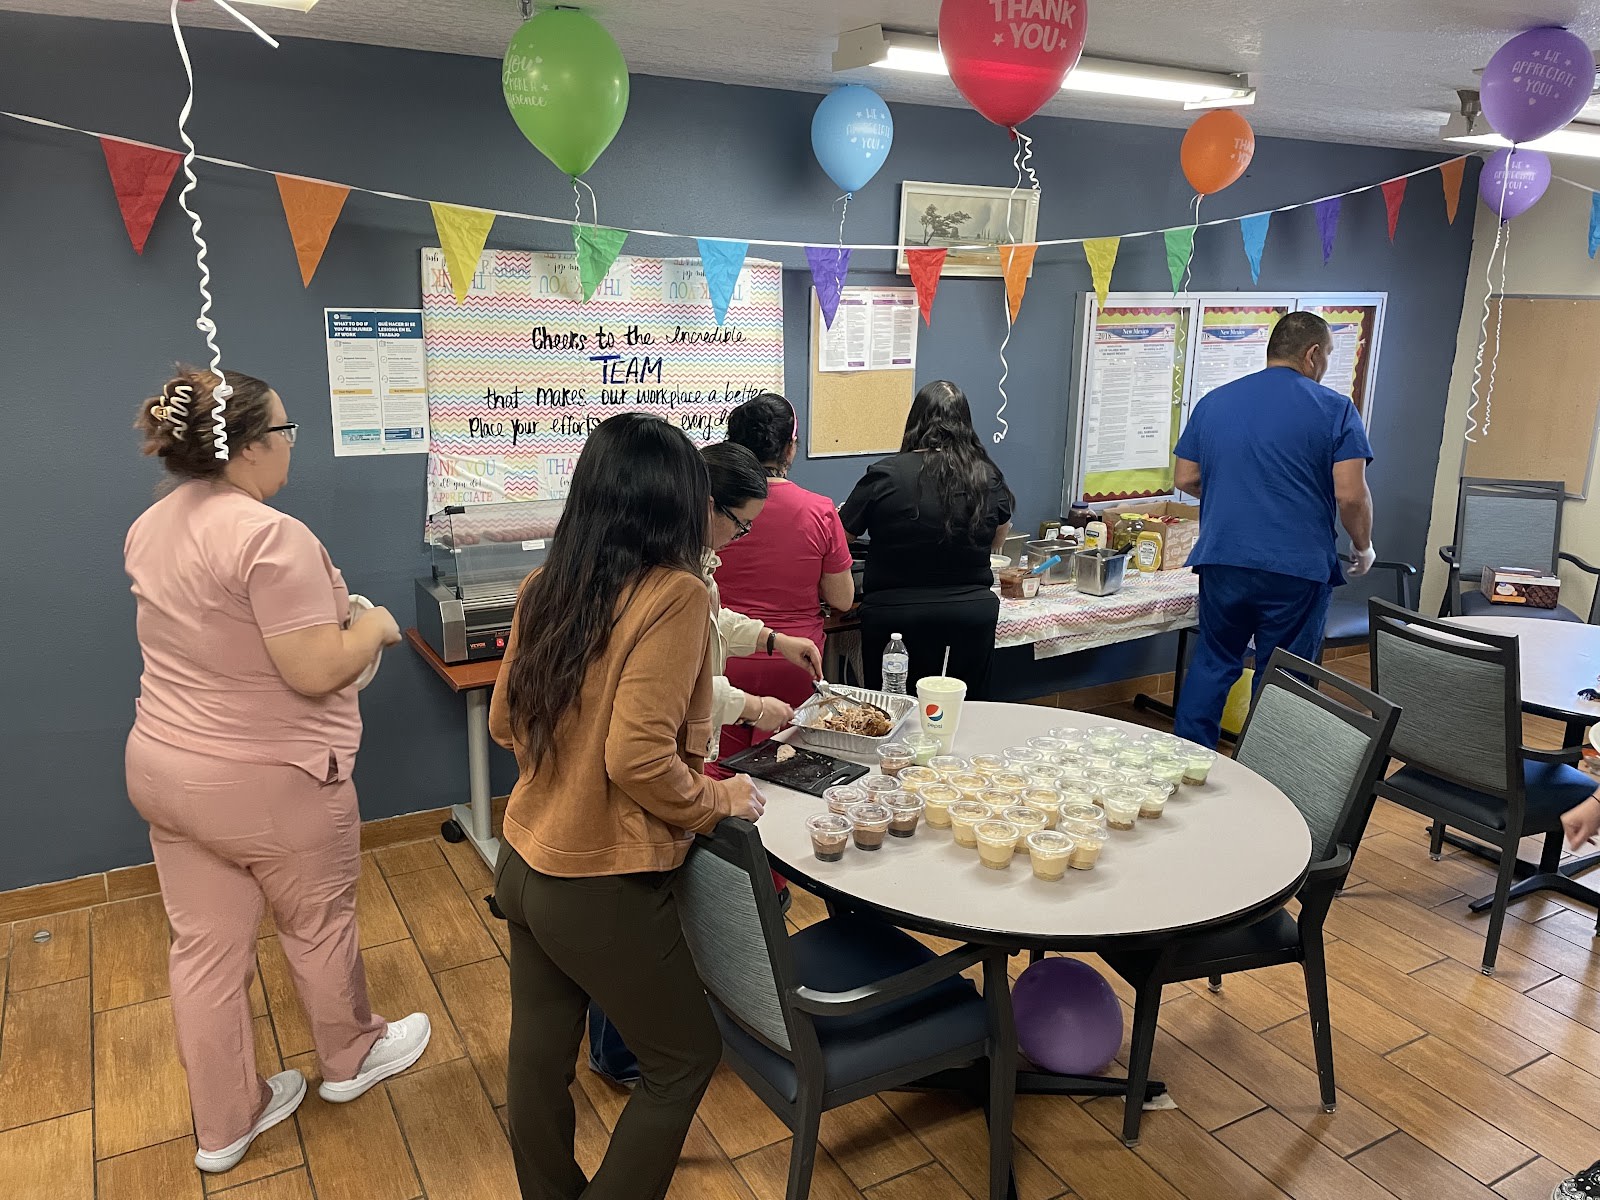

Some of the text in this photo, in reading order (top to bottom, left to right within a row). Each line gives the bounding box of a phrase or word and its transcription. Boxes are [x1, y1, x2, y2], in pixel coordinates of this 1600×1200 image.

[989, 0, 1076, 29] THANK
[1009, 21, 1059, 52] YOU
[1544, 50, 1562, 64] WE
[1511, 61, 1577, 88] APPRECIATE
[1525, 78, 1553, 97] YOU!
[596, 325, 615, 349] to
[624, 325, 655, 346] the
[590, 354, 663, 384] TEAM
[483, 386, 523, 409] that
[601, 388, 627, 405] our
[637, 383, 705, 409] workplace
[708, 390, 721, 403] a
[511, 418, 539, 445] your
[550, 414, 601, 436] efforts
[465, 459, 496, 477] YOU
[432, 491, 493, 503] APPRECIATE
